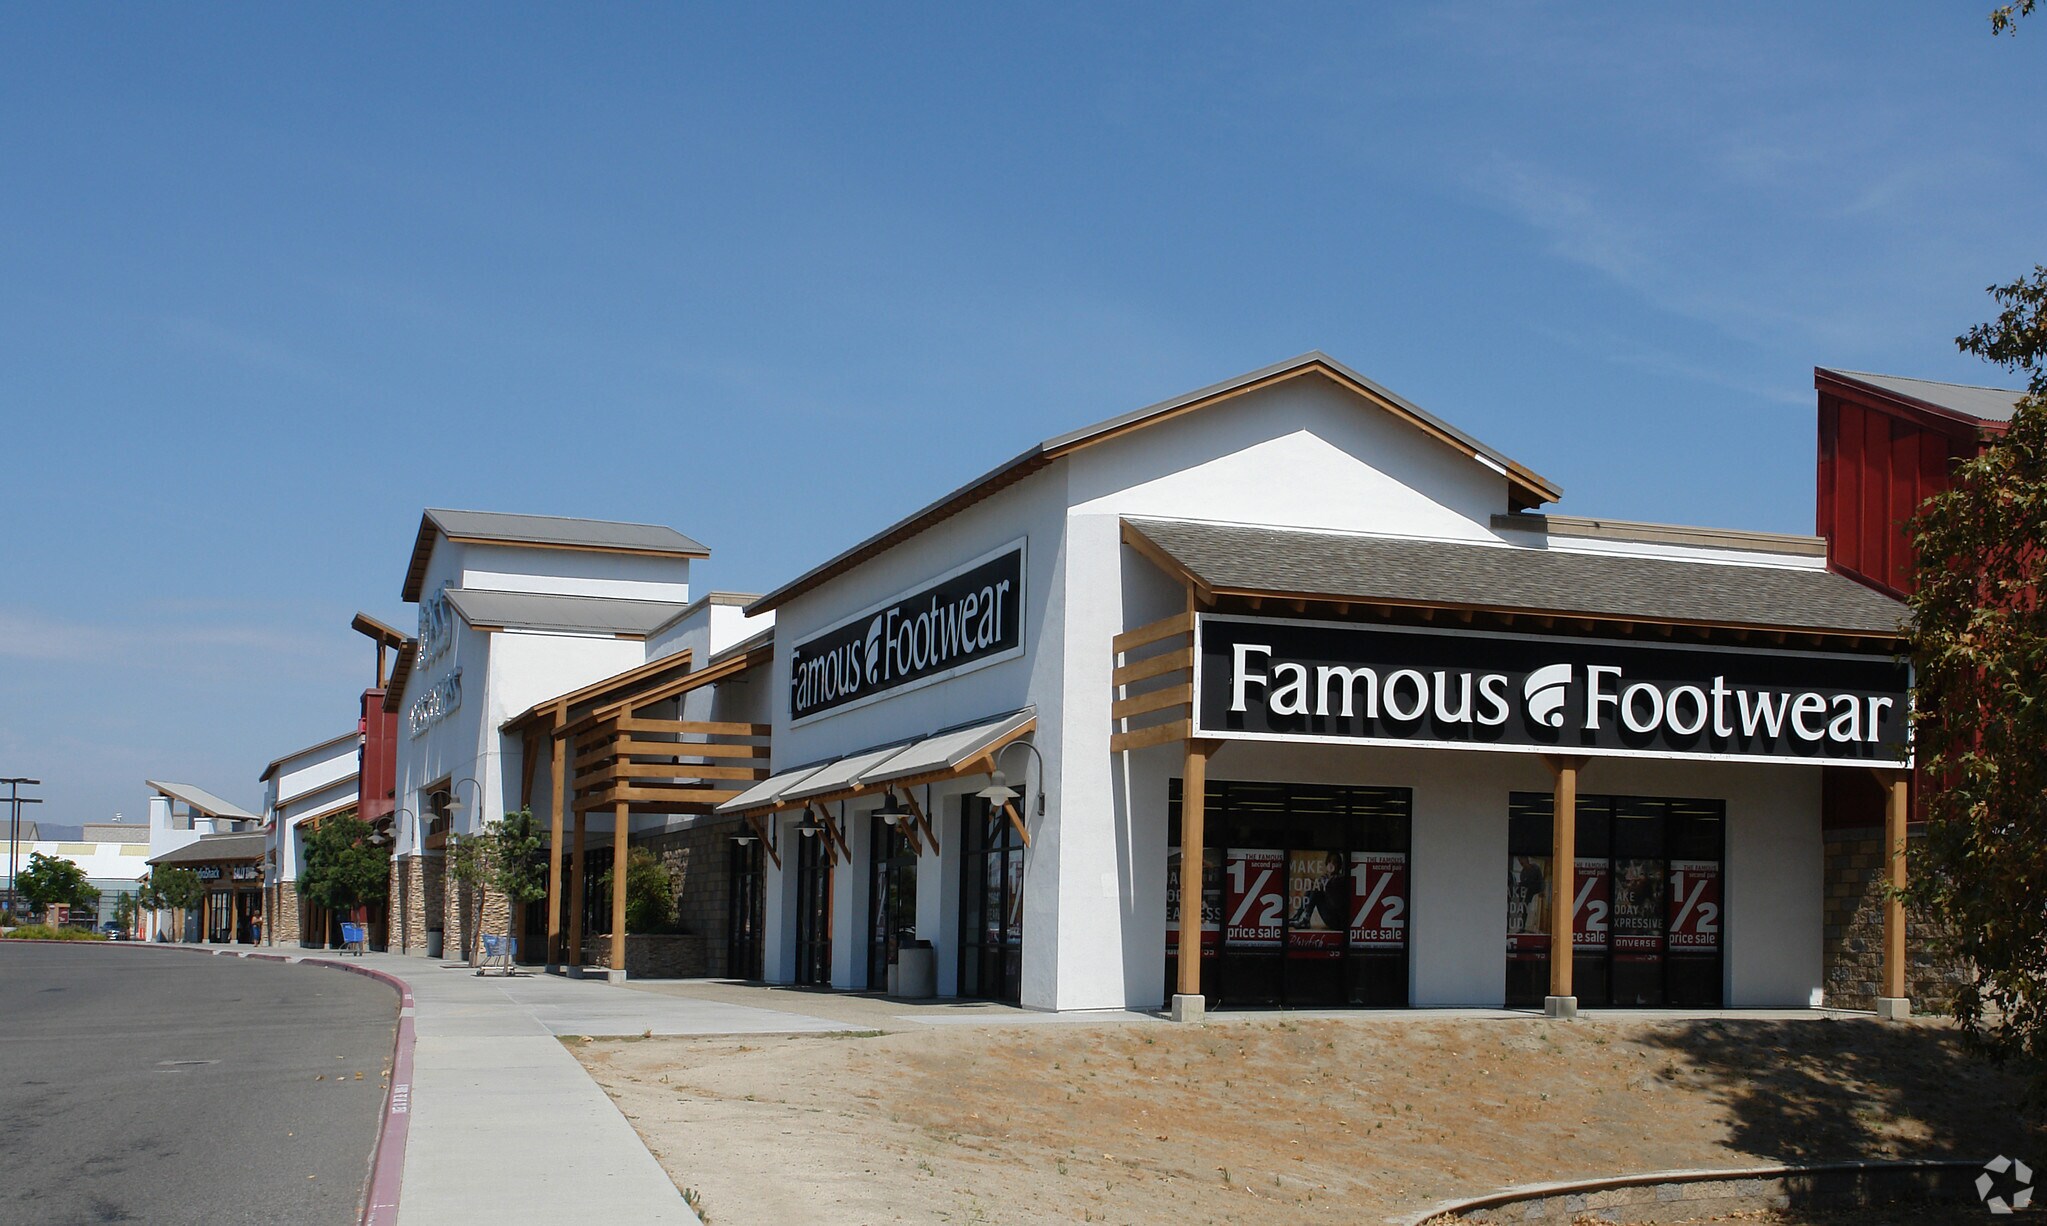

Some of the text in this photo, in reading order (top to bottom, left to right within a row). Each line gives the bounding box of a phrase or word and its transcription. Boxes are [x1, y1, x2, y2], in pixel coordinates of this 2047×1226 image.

[791, 579, 1009, 711] Famous Footwear
[1230, 643, 1893, 743] Famous Footwear
[1616, 891, 1635, 902] AKE
[1614, 904, 1640, 915] ODAY
[1614, 918, 1663, 929] XPRESSIVE
[1227, 926, 1281, 940] price sale
[1350, 927, 1402, 942] price sale
[1585, 931, 1606, 943] sale
[1669, 932, 1716, 946] price sale
[1615, 939, 1657, 948] ONVERSE
